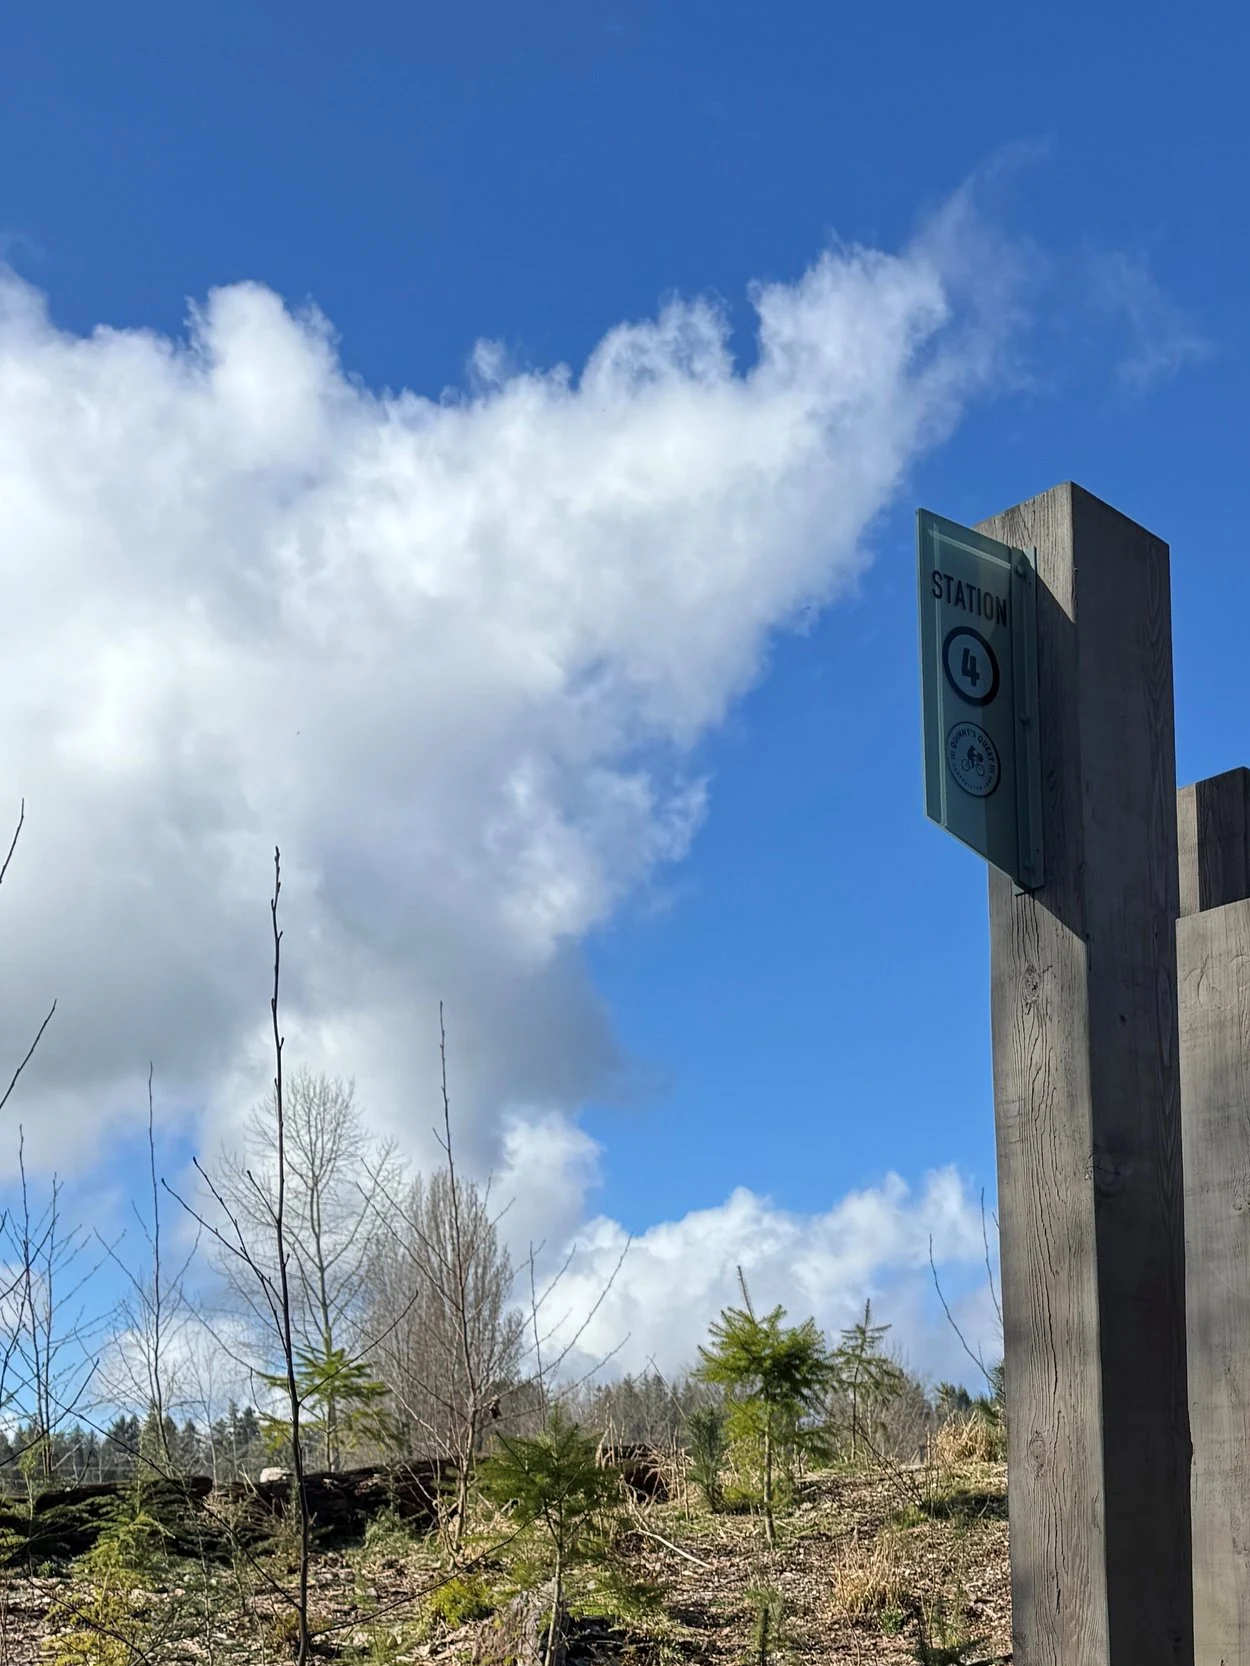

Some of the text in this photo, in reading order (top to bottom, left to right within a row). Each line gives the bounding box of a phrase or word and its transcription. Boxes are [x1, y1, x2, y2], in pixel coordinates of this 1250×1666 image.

[932, 570, 1007, 627] STATION
[961, 647, 981, 686] 4
[977, 735, 995, 762] QUEST
